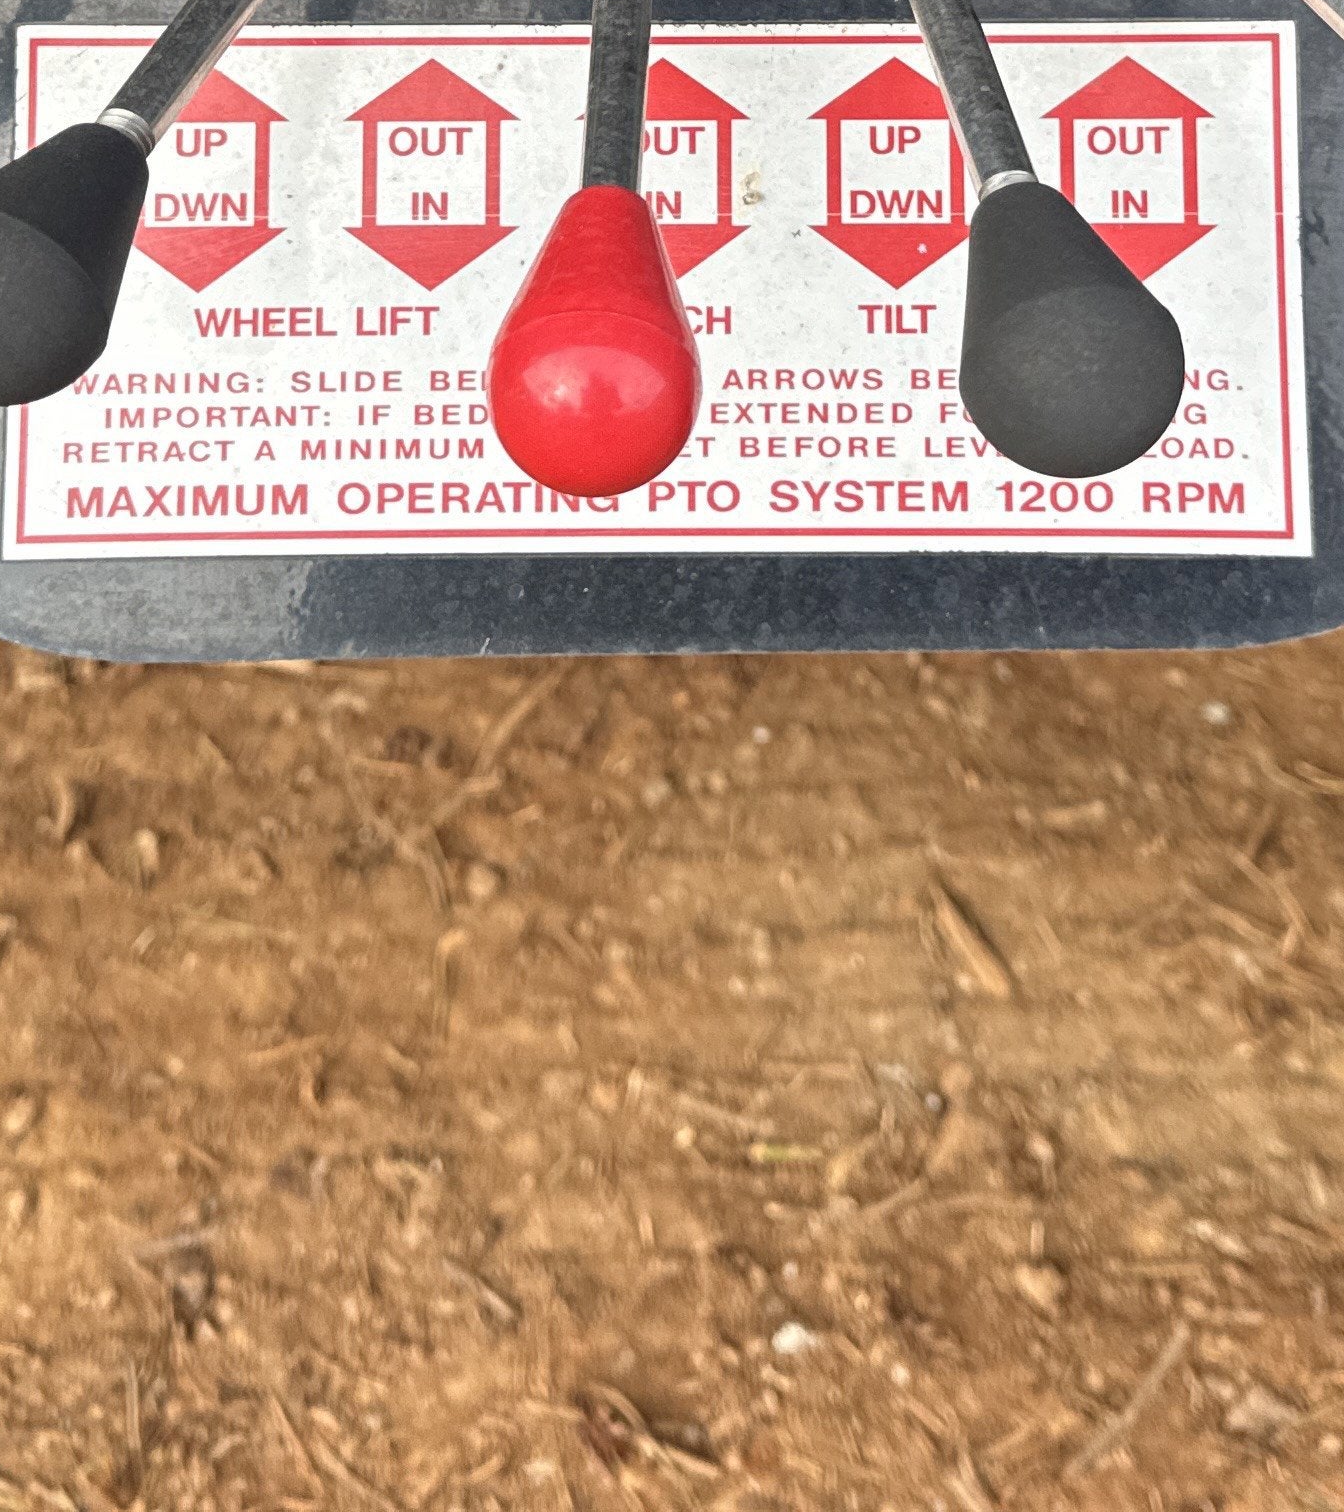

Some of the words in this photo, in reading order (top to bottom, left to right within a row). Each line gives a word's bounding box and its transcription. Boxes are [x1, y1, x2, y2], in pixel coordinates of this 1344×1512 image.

[175, 128, 228, 157] UP
[388, 126, 472, 157] OUT
[642, 126, 706, 156] UT
[869, 126, 922, 156] UP
[1086, 125, 1170, 156] OUT
[153, 192, 248, 222] DWN
[410, 191, 449, 221] IN
[849, 188, 944, 219] DWN
[1111, 189, 1149, 219] IN
[194, 307, 338, 338] WHEEL
[355, 305, 440, 337] LIFT
[857, 303, 938, 335] TILT
[73, 371, 265, 394] WARNING:
[291, 370, 403, 393] SLIDE
[430, 370, 487, 391] BE
[722, 368, 884, 390] ARROWS
[105, 405, 331, 428] IMPORTANT:
[358, 405, 392, 426] IF
[414, 404, 489, 426] BED
[710, 401, 913, 424] EXTENDED
[63, 440, 236, 464] RETRACT
[255, 440, 276, 461] A
[301, 437, 485, 460] MINIMUM
[740, 436, 897, 458] BEFORE
[66, 484, 309, 519] MAXIMUM
[337, 480, 619, 515] OPERATING
[648, 480, 741, 513] PTO
[769, 480, 969, 514] SYSTEM
[995, 480, 1115, 513] 1200
[1142, 481, 1246, 515] RPM
